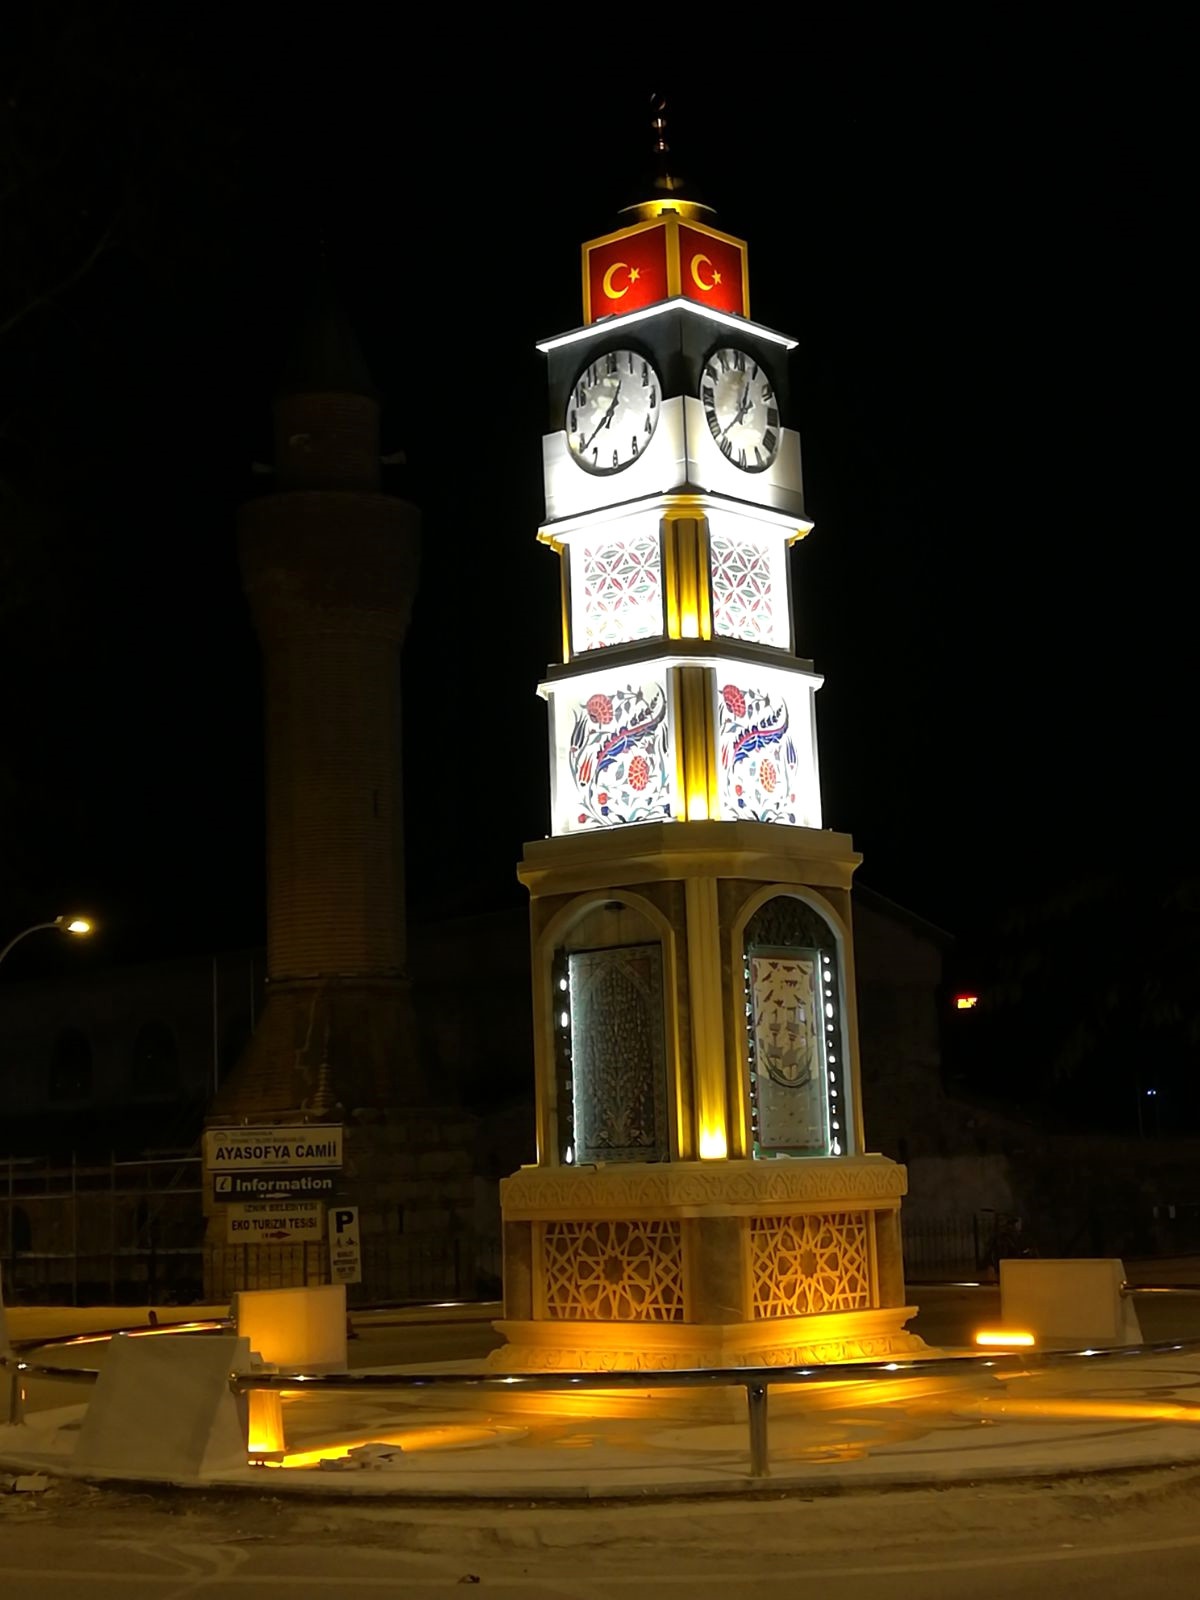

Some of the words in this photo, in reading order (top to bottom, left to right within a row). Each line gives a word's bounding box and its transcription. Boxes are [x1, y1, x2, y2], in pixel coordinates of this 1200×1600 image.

[215, 1145, 291, 1160] AYASOFYA
[236, 1176, 333, 1192] Information
[232, 1219, 250, 1231] EKO
[336, 1211, 354, 1233] P
